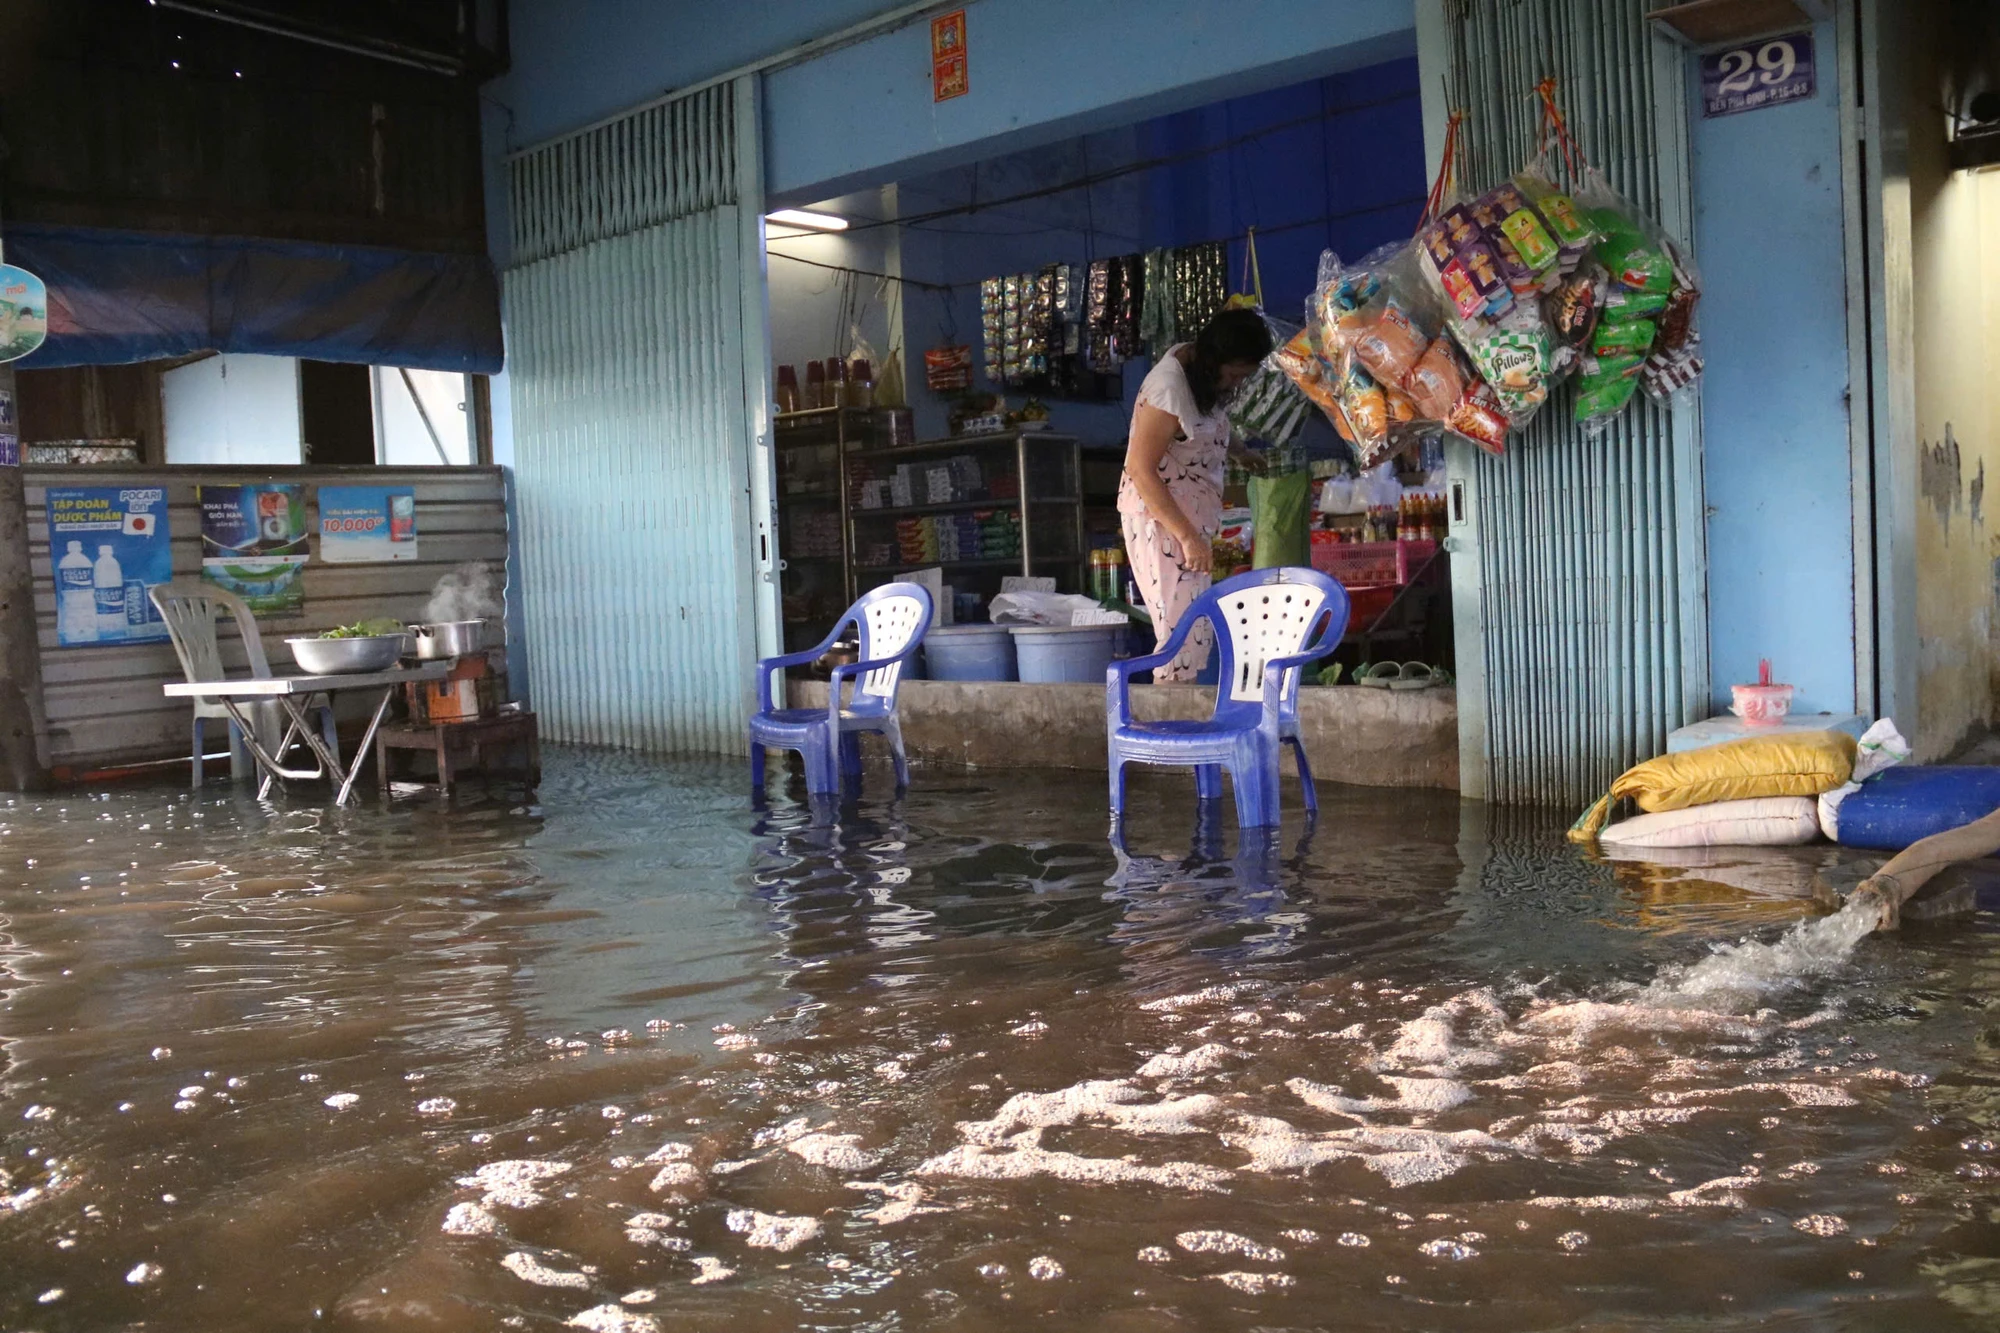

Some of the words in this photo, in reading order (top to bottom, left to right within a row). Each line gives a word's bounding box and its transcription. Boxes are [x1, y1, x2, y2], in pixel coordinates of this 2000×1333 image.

[1719, 41, 1796, 95] 29
[1495, 352, 1533, 372] Pillows
[1469, 395, 1488, 408] TÔM
[121, 491, 161, 501] POCARI
[51, 499, 73, 512] TẬP
[76, 498, 109, 510] ĐOÀN
[53, 512, 86, 523] DƯỢC
[89, 509, 122, 521] PHẨM
